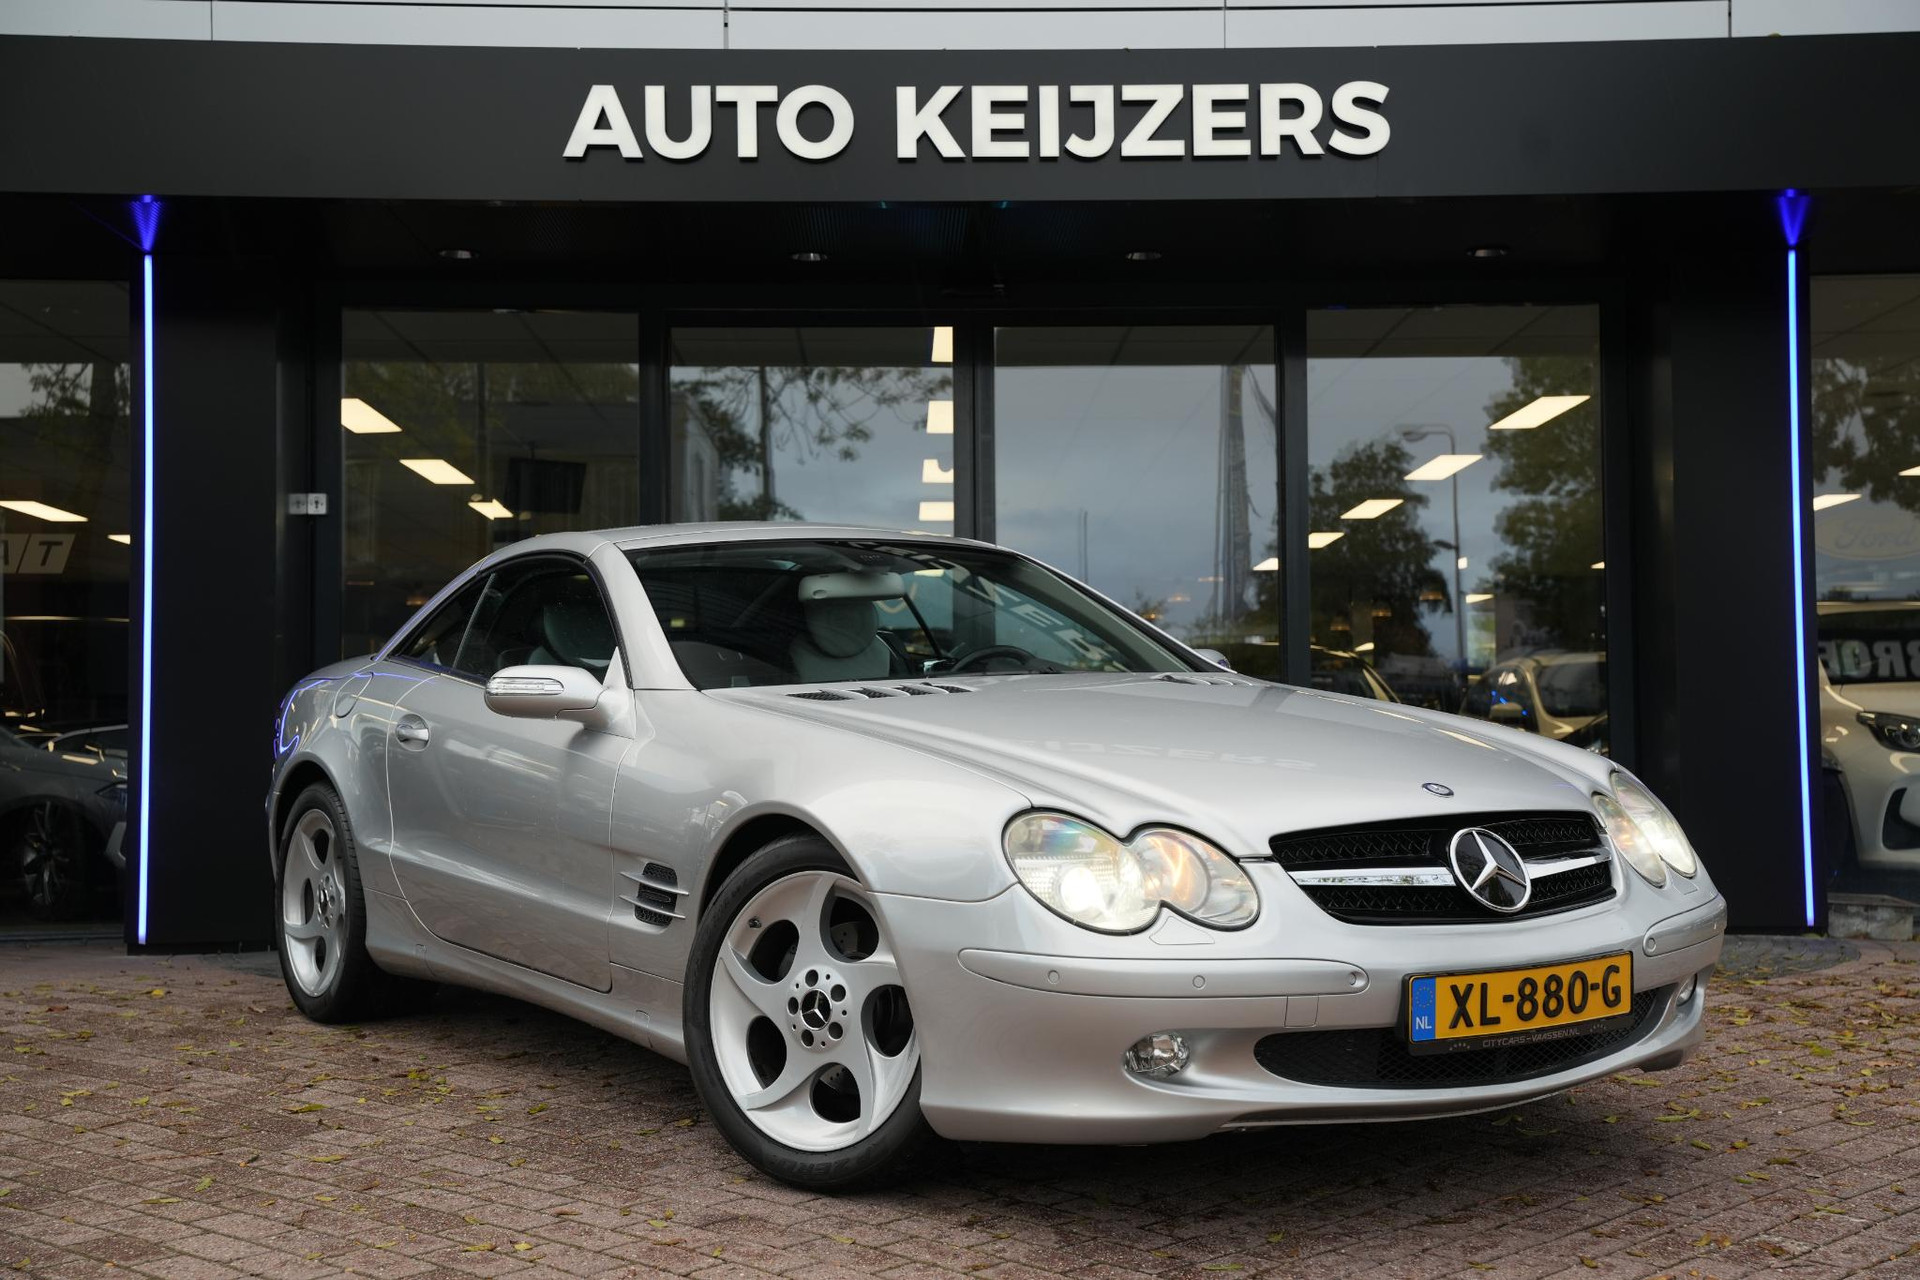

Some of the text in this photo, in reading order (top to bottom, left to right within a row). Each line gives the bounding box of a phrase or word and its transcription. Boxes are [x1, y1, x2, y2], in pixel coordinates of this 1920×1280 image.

[562, 80, 1392, 160] AUTO KEIJZERS
[1415, 1015, 1433, 1030] NL
[1448, 964, 1622, 1030] XL-880-G
